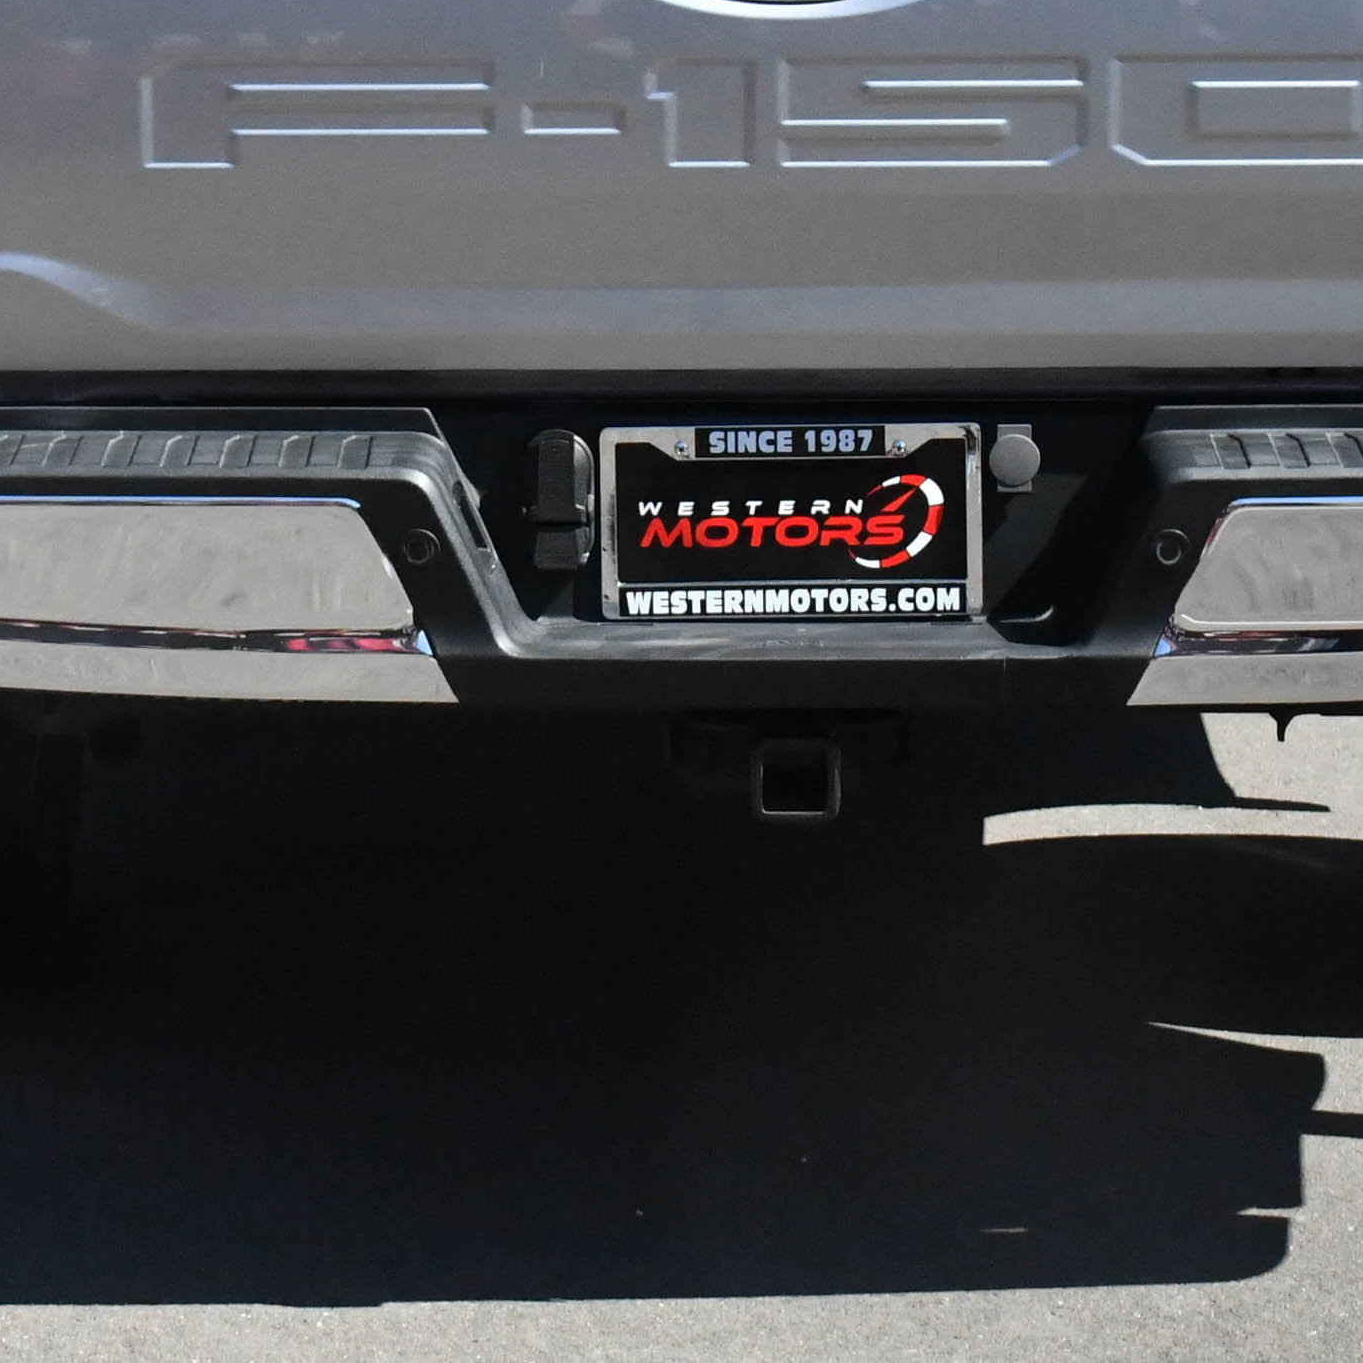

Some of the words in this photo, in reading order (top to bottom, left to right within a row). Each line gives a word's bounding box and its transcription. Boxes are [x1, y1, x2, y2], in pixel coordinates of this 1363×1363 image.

[709, 430, 793, 454] SINCE
[803, 428, 874, 453] 1987
[638, 498, 864, 517] WESTERN
[639, 514, 905, 549] MOTORS
[626, 587, 961, 615] WESTERNMOTORS.COM
